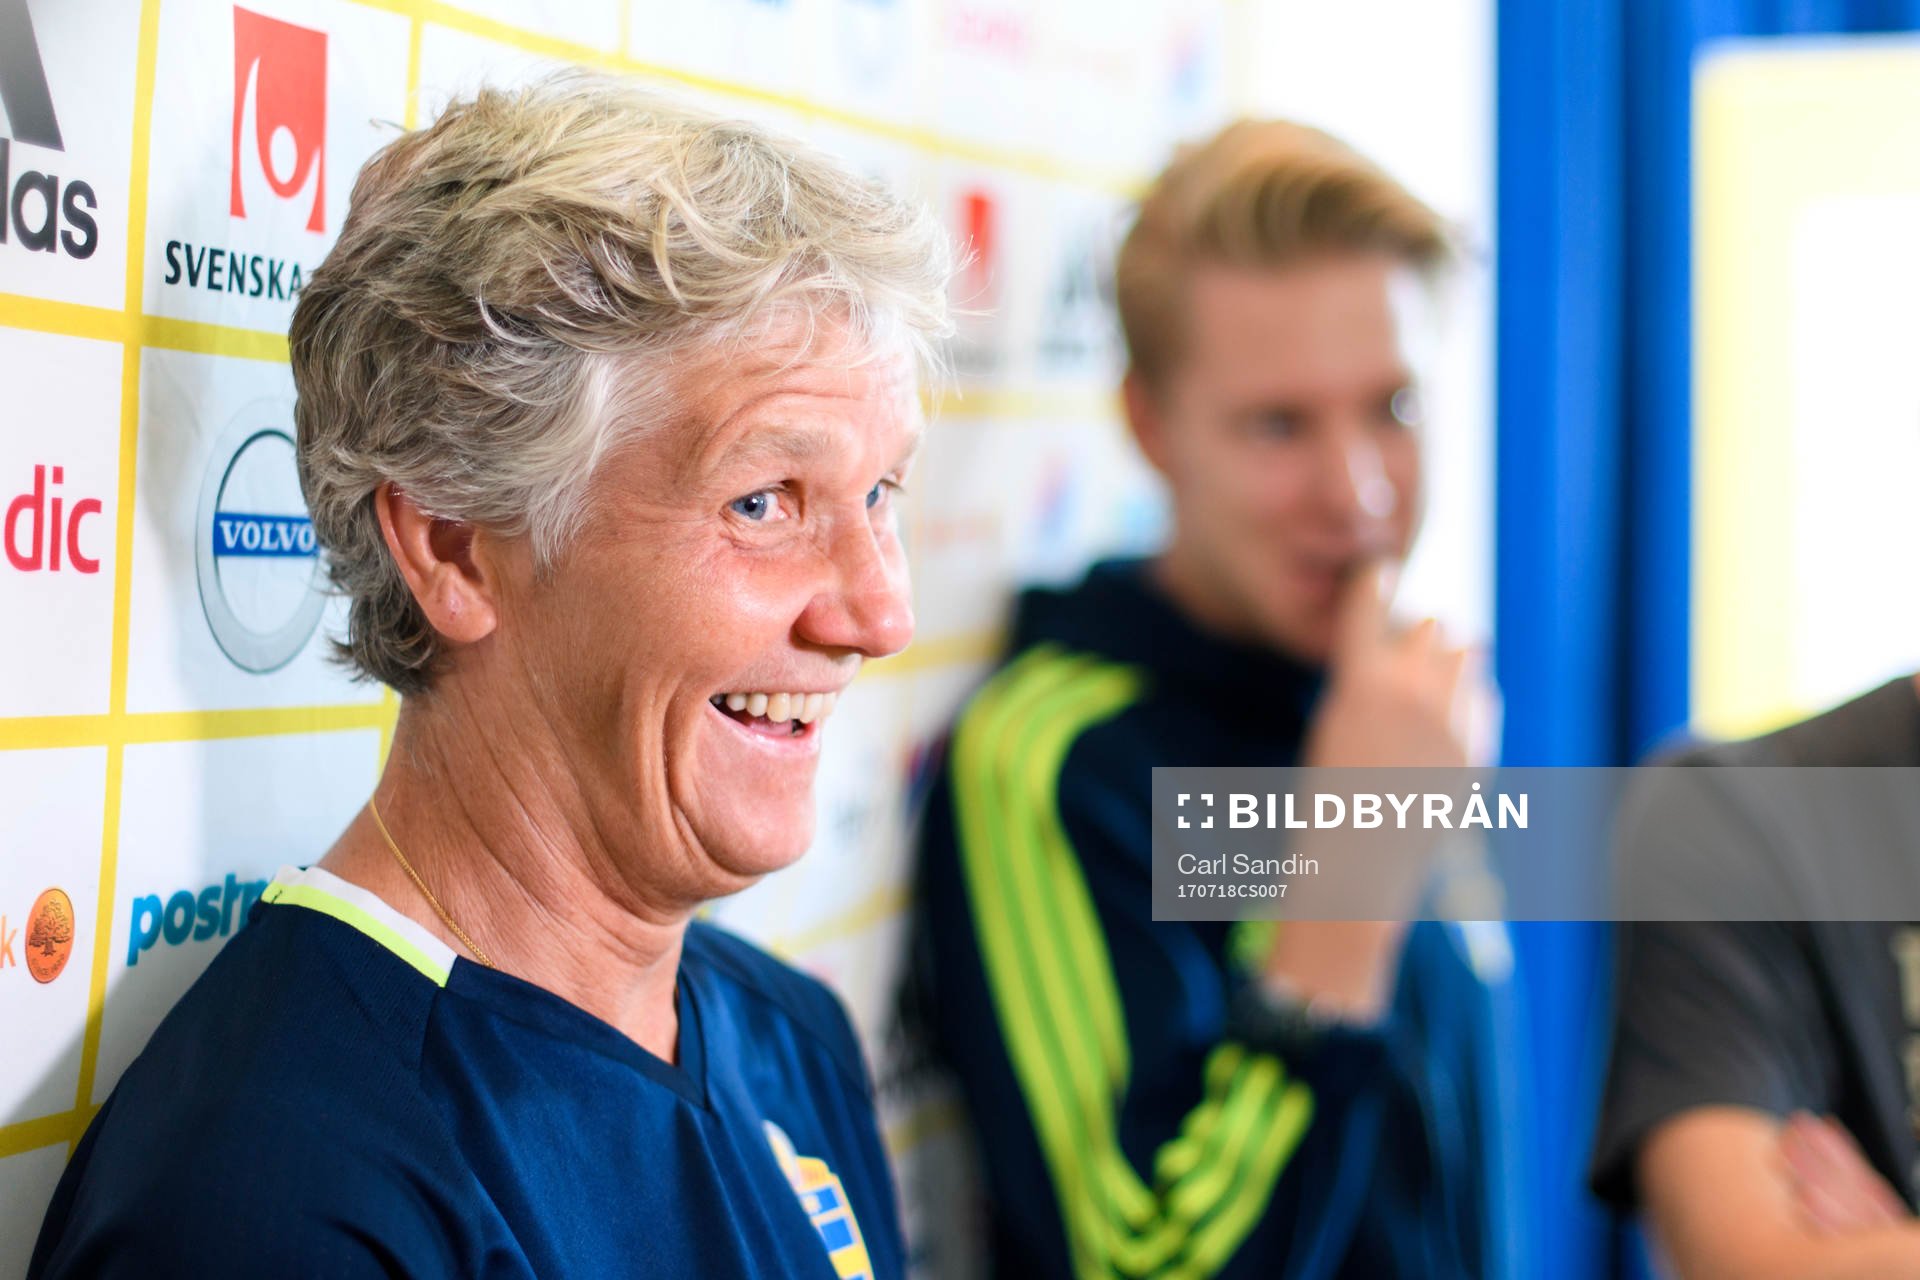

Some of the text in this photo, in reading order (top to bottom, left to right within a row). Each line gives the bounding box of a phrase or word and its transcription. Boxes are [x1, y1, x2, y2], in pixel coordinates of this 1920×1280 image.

[165, 240, 302, 300] SVENSKA
[4, 464, 102, 573] dic
[220, 520, 316, 552] VOLVO
